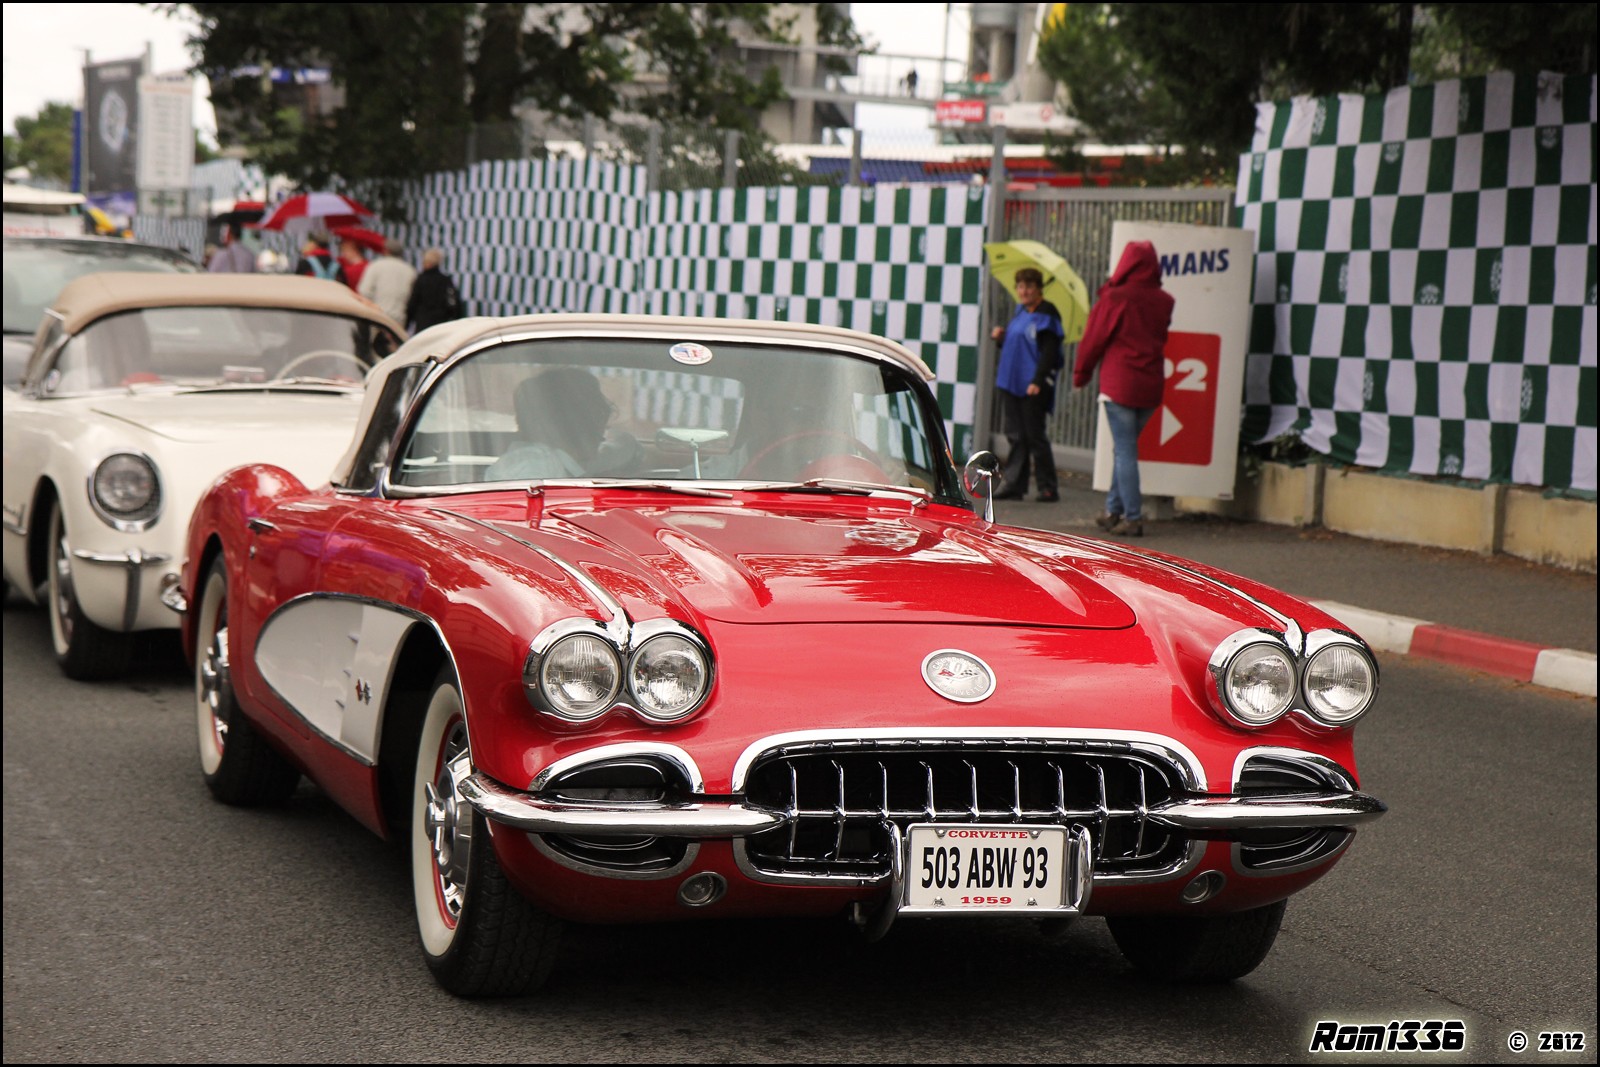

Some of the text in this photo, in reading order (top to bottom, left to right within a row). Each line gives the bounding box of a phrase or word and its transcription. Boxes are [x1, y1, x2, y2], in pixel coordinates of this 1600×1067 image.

[1160, 249, 1229, 277] MANS
[948, 830, 1028, 839] CORVETTE
[921, 846, 1048, 889] 503 ABW 93
[960, 896, 1012, 905] 1959
